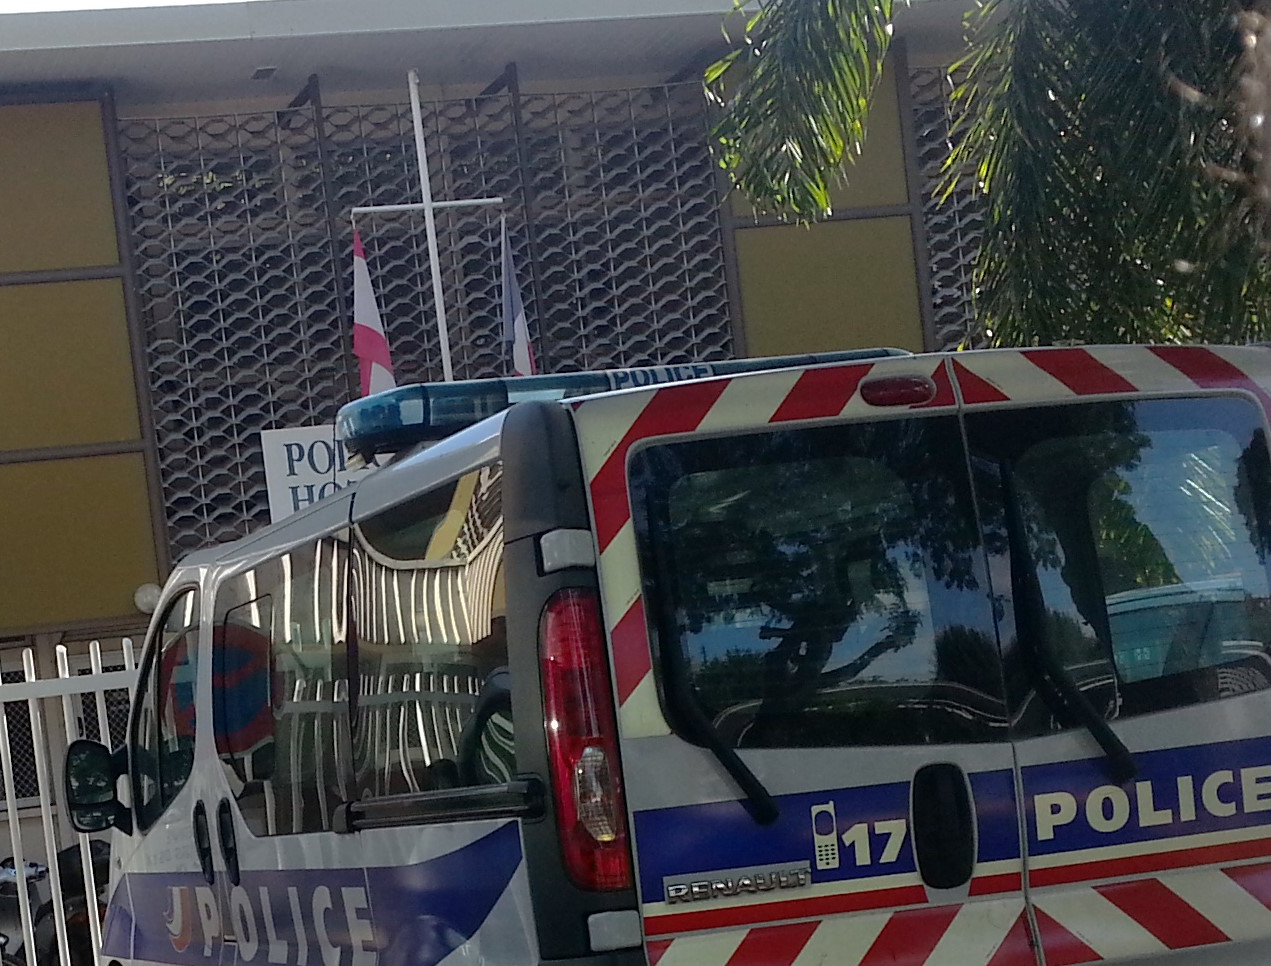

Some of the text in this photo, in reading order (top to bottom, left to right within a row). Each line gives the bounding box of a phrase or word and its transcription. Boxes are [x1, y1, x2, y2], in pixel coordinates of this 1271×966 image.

[612, 365, 709, 390] POLICE
[1034, 764, 1271, 841] POLICE
[841, 819, 907, 867] 17
[667, 867, 812, 905] RENAULT
